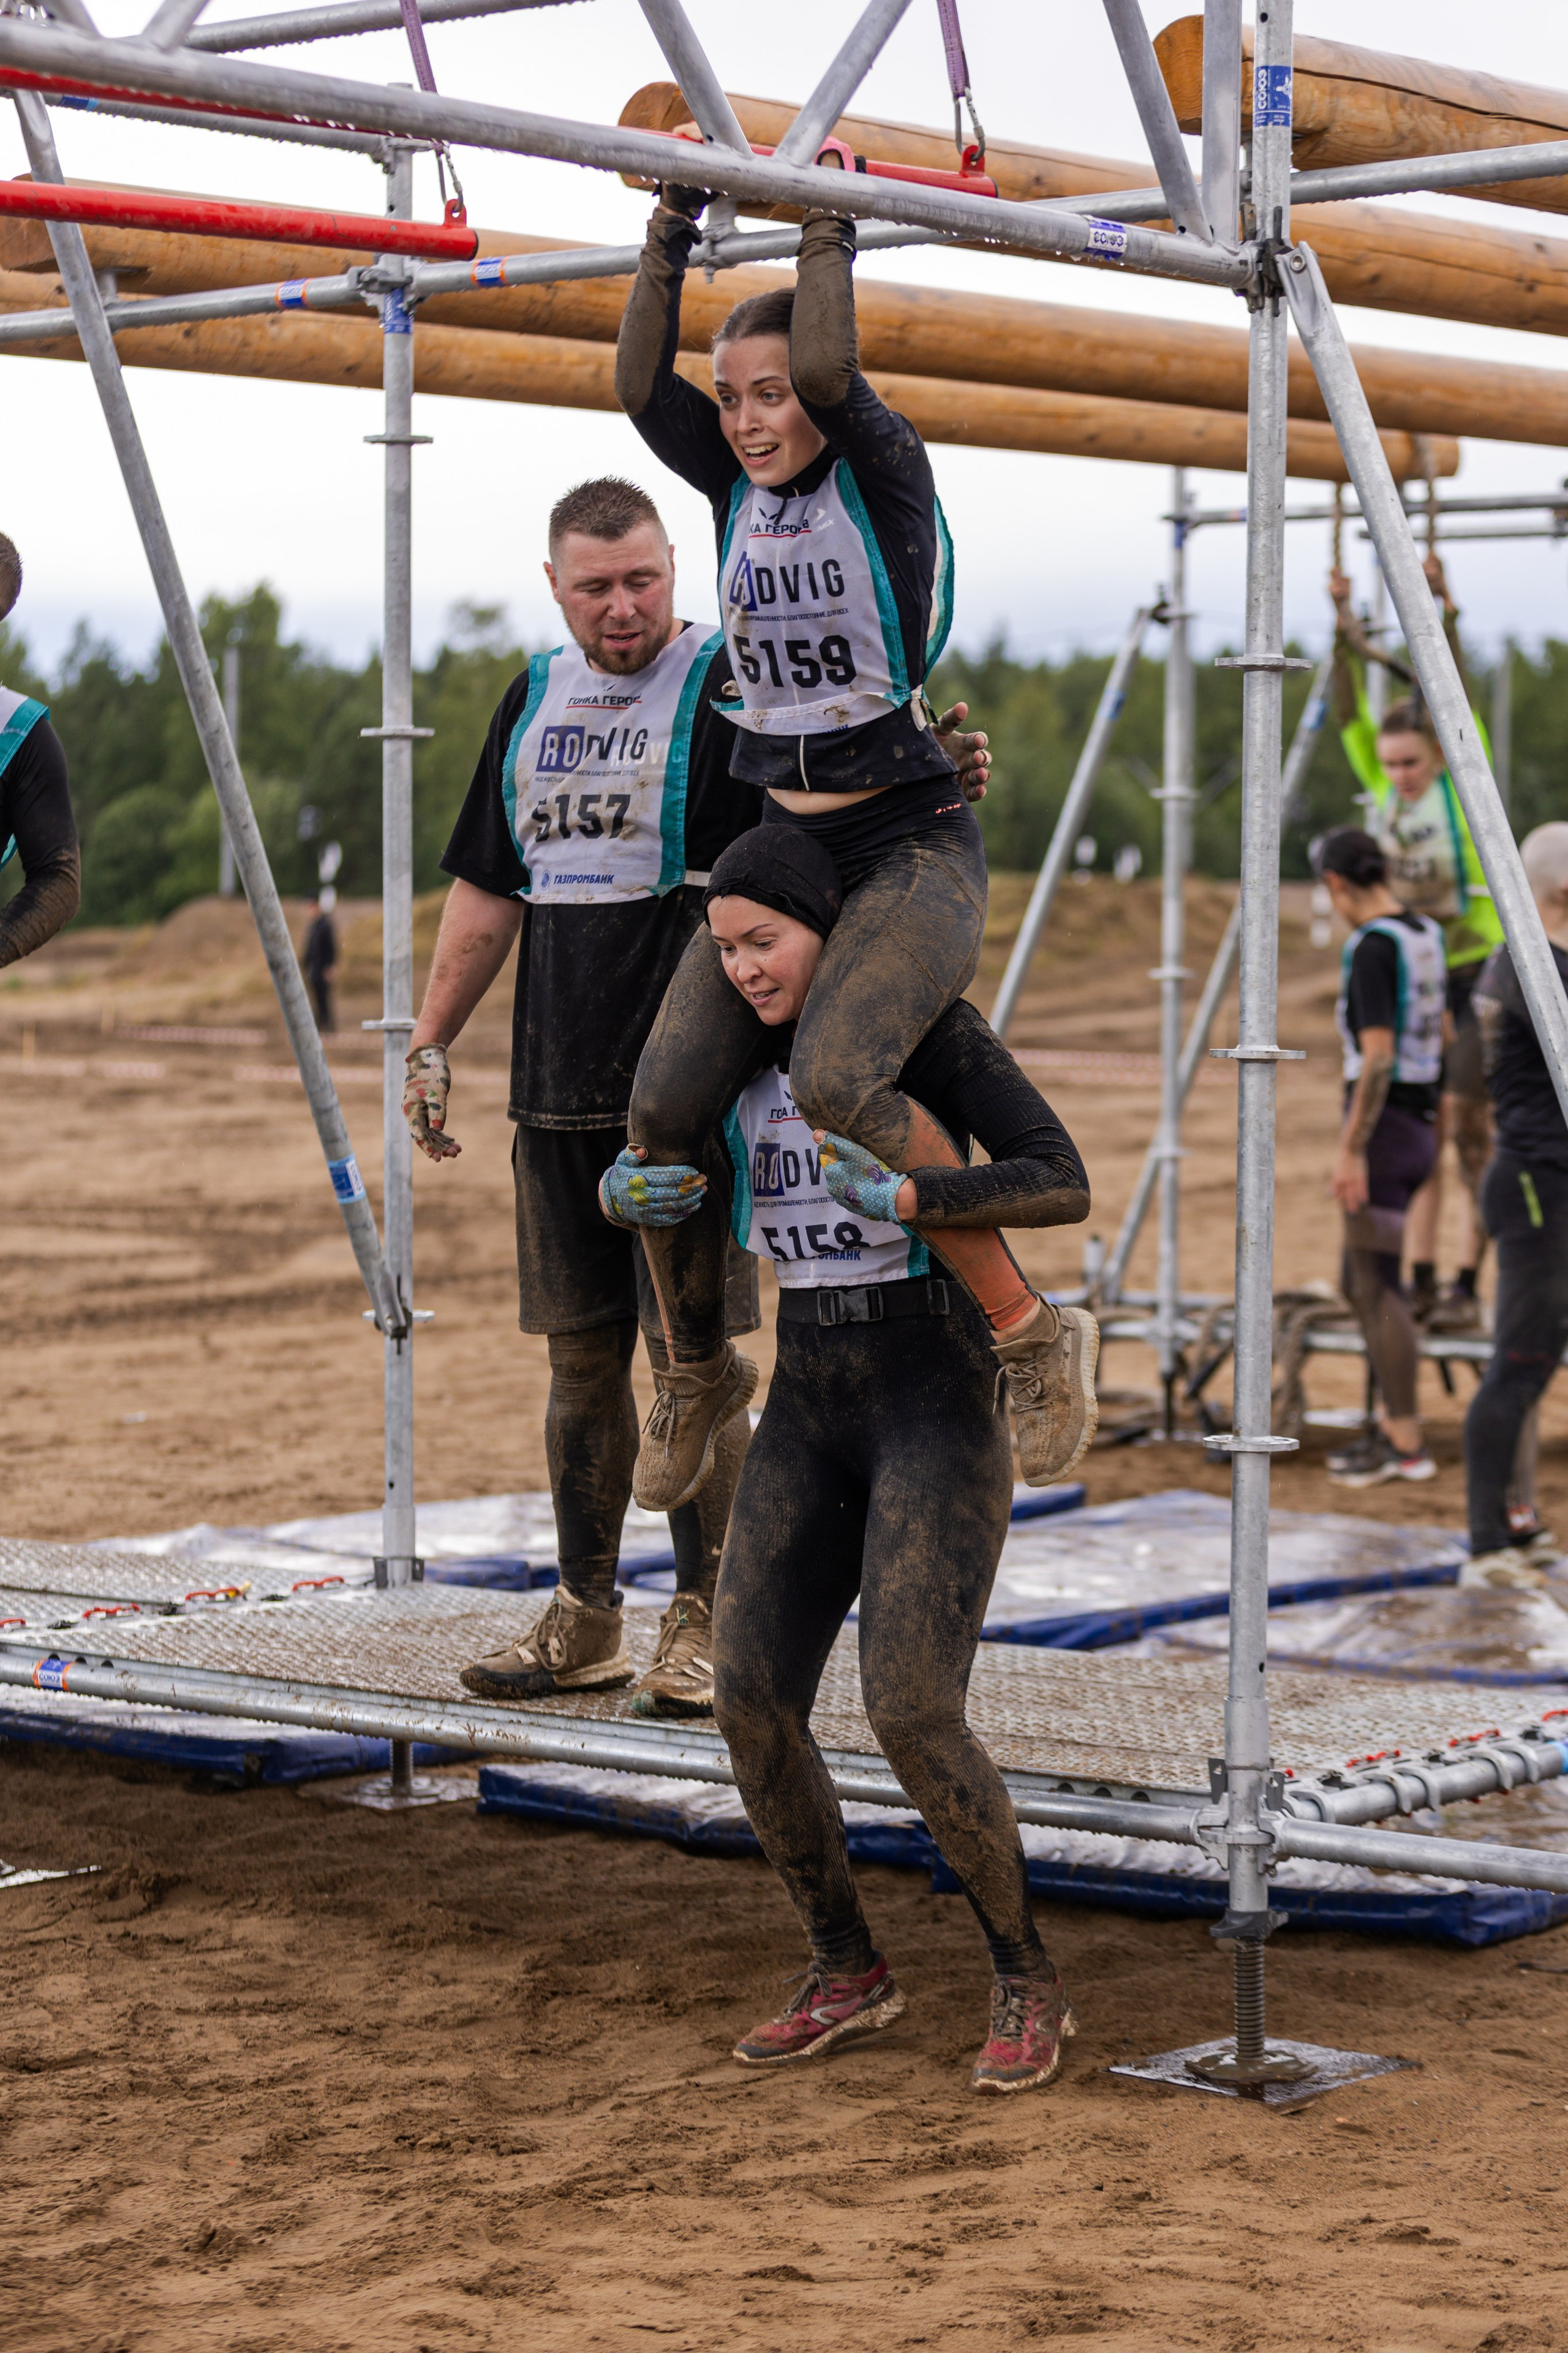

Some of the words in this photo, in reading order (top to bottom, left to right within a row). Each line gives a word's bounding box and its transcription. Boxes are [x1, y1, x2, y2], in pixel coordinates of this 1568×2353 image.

[733, 635, 856, 689] 5159
[568, 695, 598, 704] ГОНКА
[531, 794, 630, 842] 5157
[554, 874, 614, 885] ГАЗПРОМБАНК
